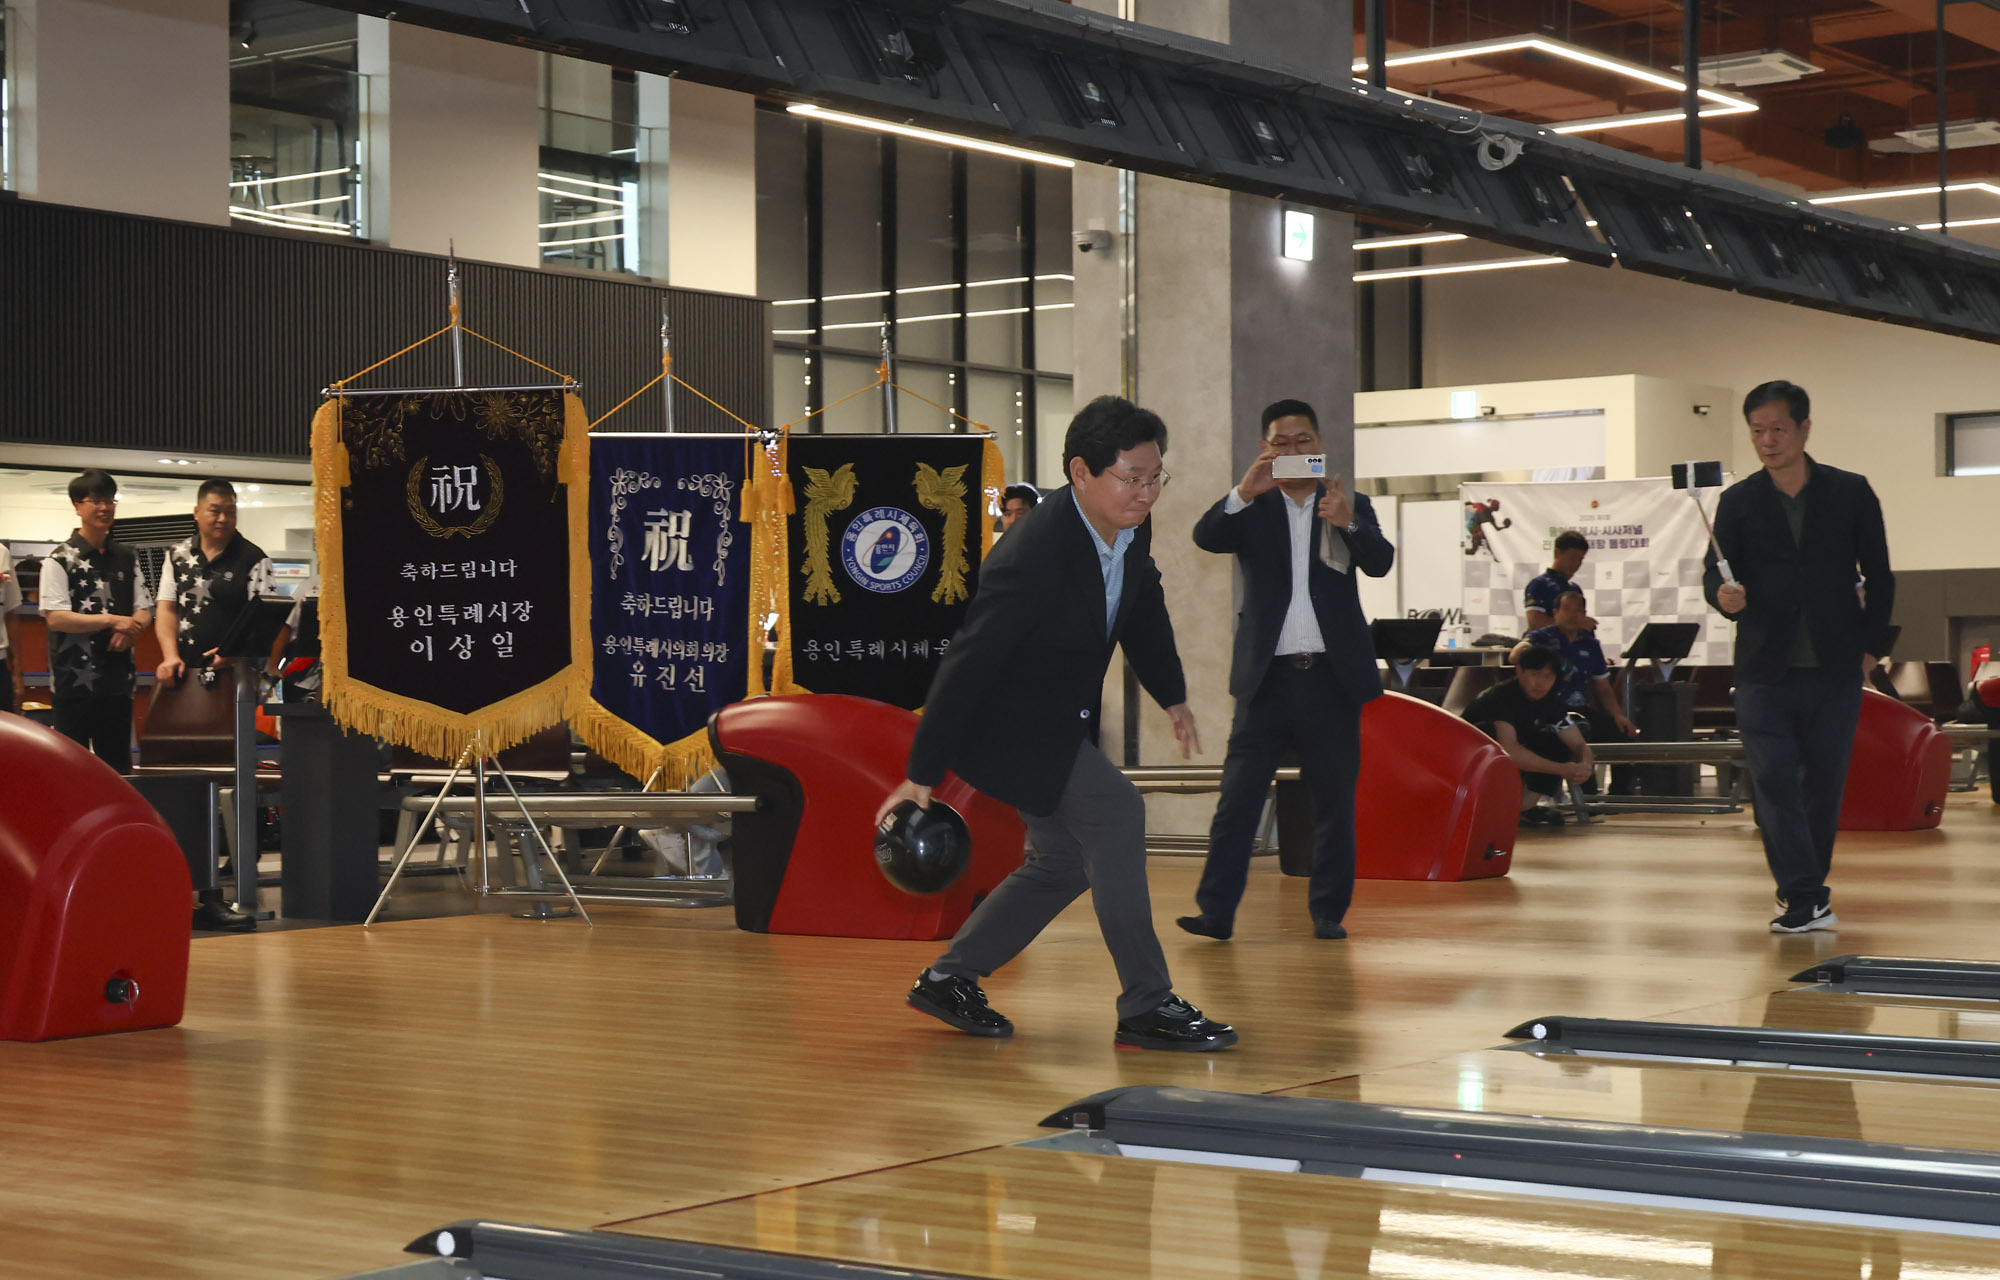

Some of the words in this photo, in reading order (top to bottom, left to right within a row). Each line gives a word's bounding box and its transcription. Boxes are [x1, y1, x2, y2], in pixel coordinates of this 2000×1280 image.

[430, 464, 481, 513] 祝
[641, 507, 694, 571] 祝
[400, 558, 518, 582] 축하드립니다
[845, 556, 869, 586] YONGIN
[869, 580, 902, 591] SPORTS
[902, 554, 927, 584] COUNCIL
[386, 600, 534, 628] 용인특례시장
[620, 591, 715, 622] 축하드립니다
[700, 641, 730, 663] 의장
